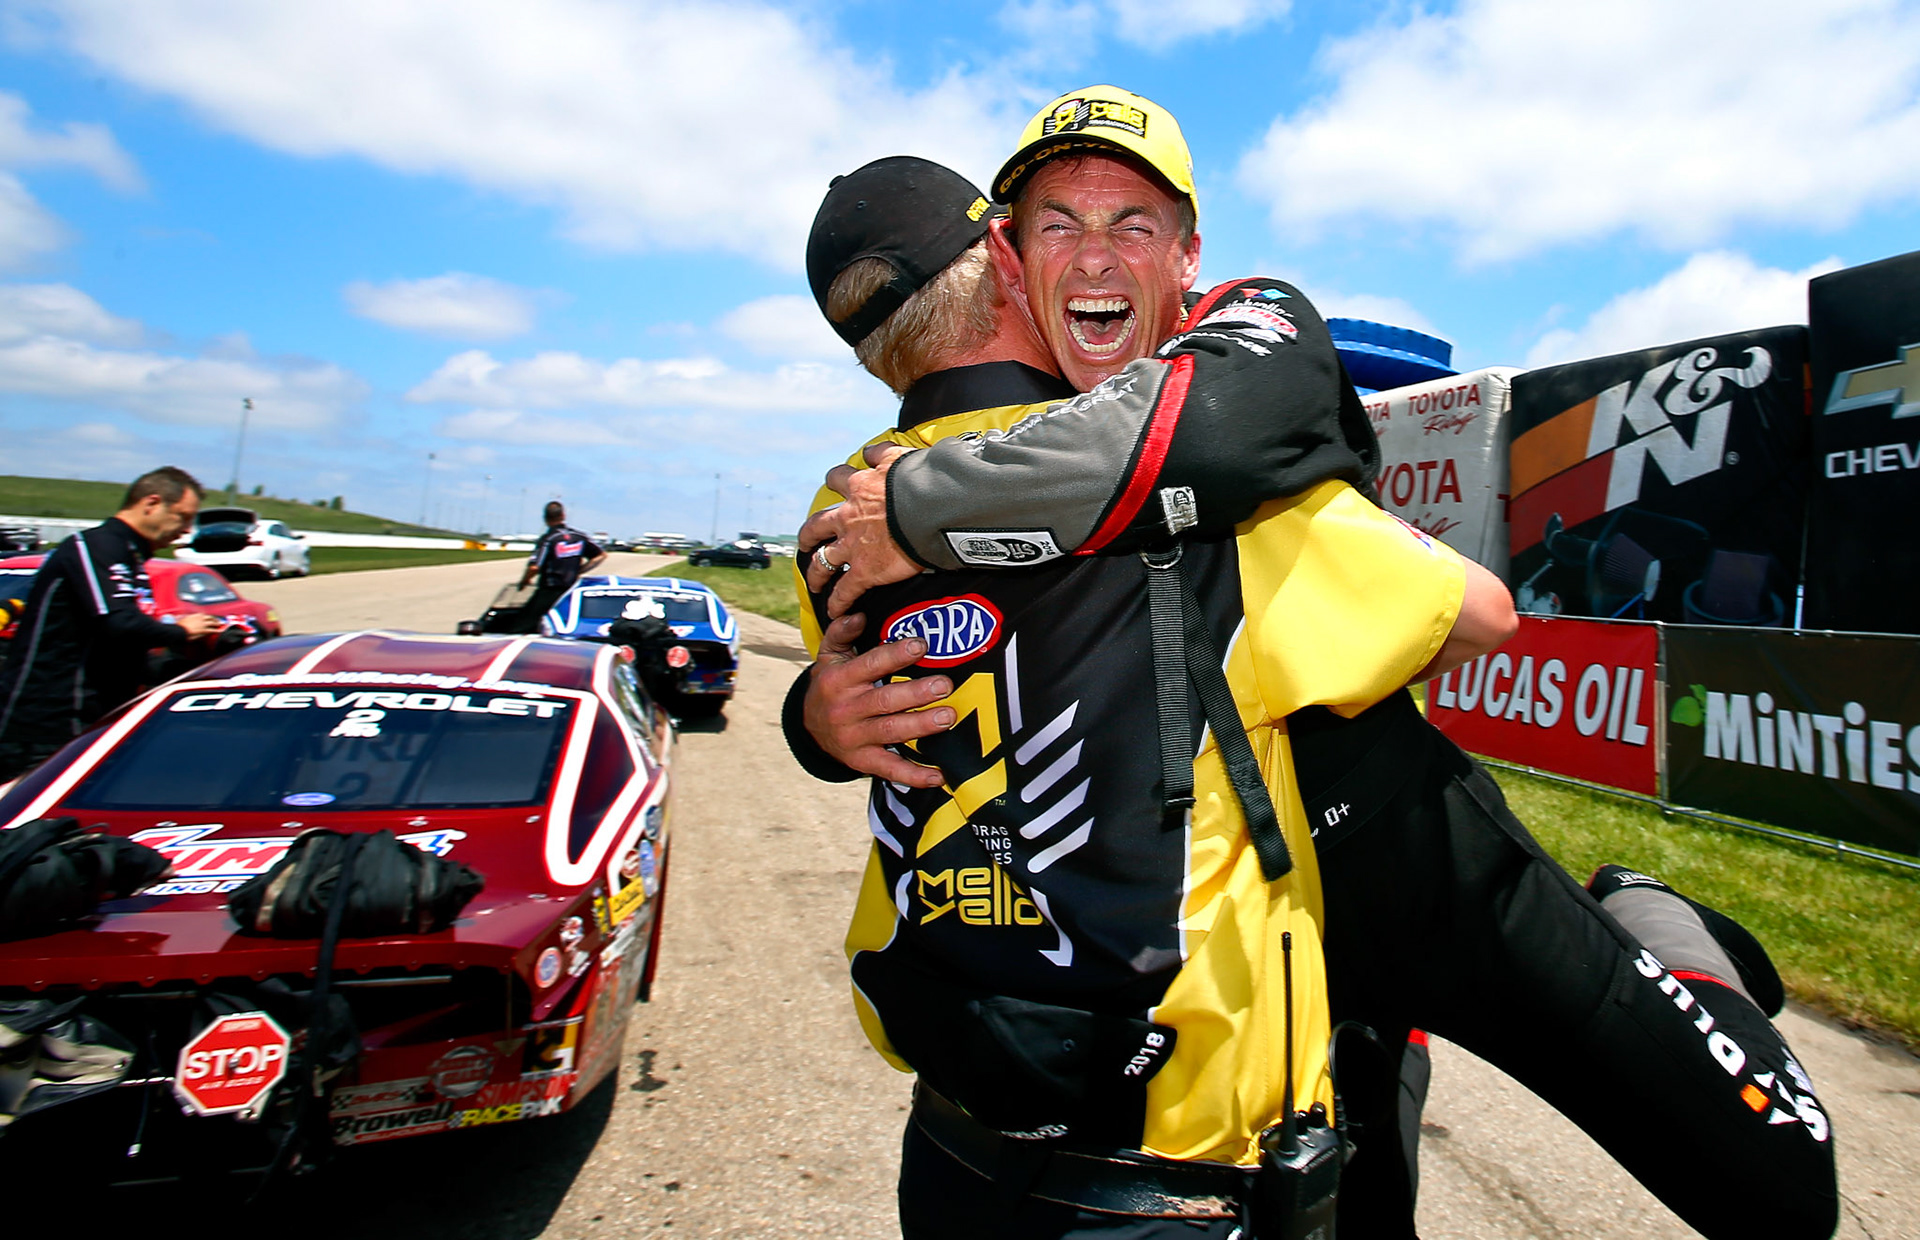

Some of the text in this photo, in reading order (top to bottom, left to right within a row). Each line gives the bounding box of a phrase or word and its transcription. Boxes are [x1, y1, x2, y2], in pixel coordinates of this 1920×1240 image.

[1408, 383, 1482, 417] TOYOTA
[1585, 345, 1773, 513] K&N
[1374, 458, 1463, 508] YOTA
[169, 691, 568, 718] CHEVROLET
[1437, 652, 1649, 746] LUCAS OIL
[185, 1043, 285, 1080] STOP
[1124, 1032, 1166, 1077] 2018
